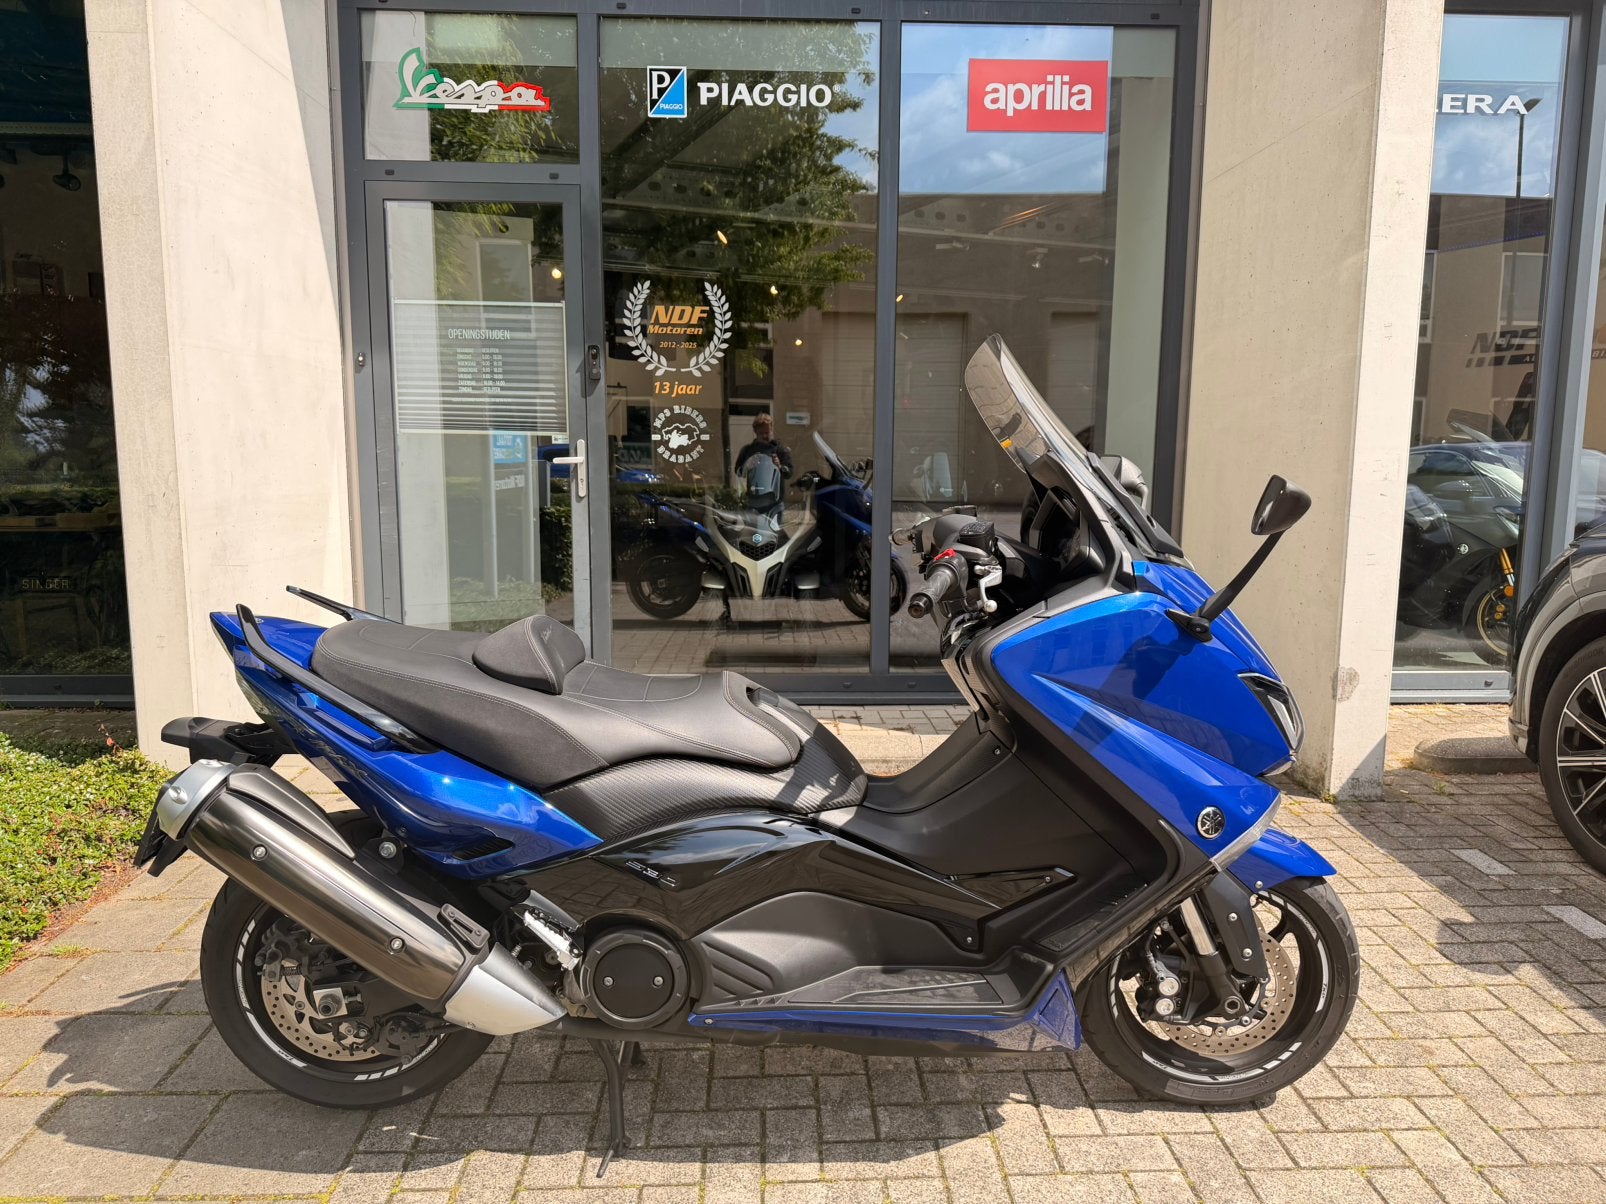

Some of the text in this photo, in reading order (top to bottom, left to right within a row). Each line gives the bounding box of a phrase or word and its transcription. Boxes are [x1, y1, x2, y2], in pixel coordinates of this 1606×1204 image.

[397, 50, 548, 110] Vespa
[650, 70, 671, 100] P
[697, 82, 832, 107] PIAGGIO
[983, 74, 1093, 117] aprilia
[1436, 93, 1528, 115] ERA
[659, 102, 683, 110] PIAGGIO
[650, 305, 710, 325] NDF
[647, 324, 704, 335] Motoren
[659, 340, 676, 348] 2012
[681, 341, 697, 349] 2025
[654, 381, 702, 398] 13 jaar
